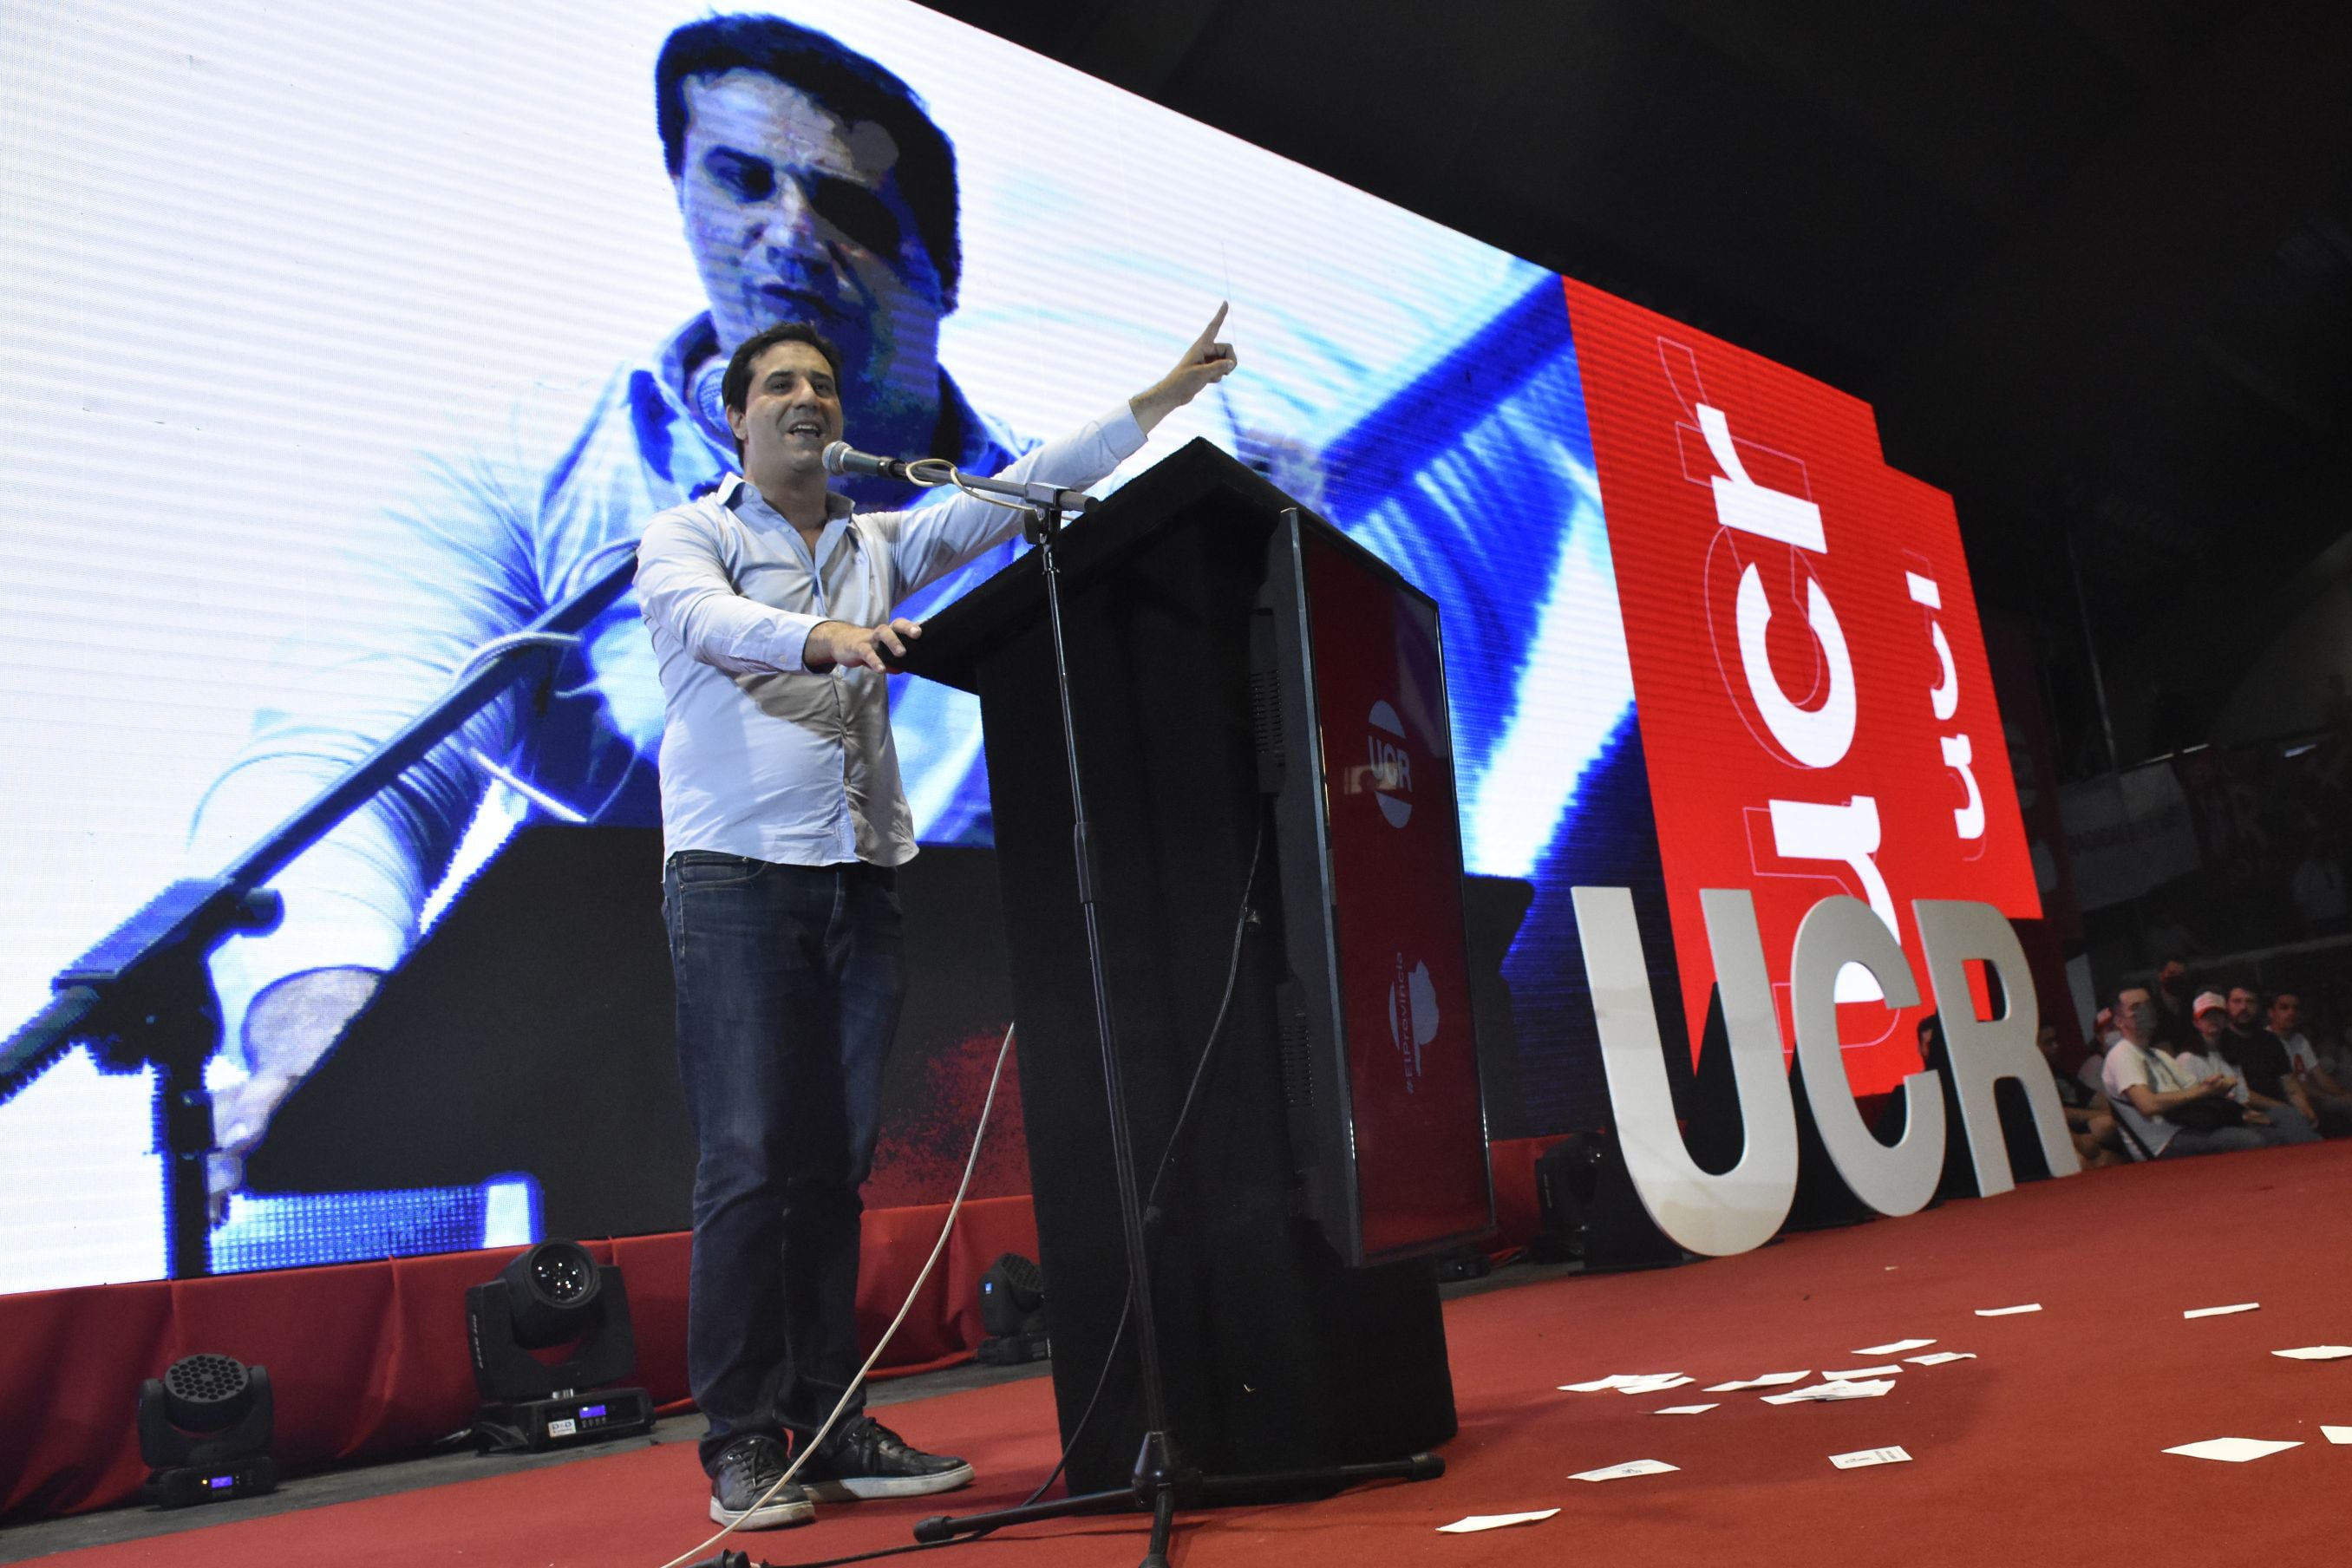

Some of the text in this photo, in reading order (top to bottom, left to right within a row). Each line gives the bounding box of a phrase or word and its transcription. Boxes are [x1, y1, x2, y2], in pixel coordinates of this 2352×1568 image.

[1368, 735, 1413, 792] UCR
[1696, 402, 1901, 1003] ucr
[1395, 952, 1415, 1095] #ElProvincia
[1571, 885, 2082, 1257] UCR
